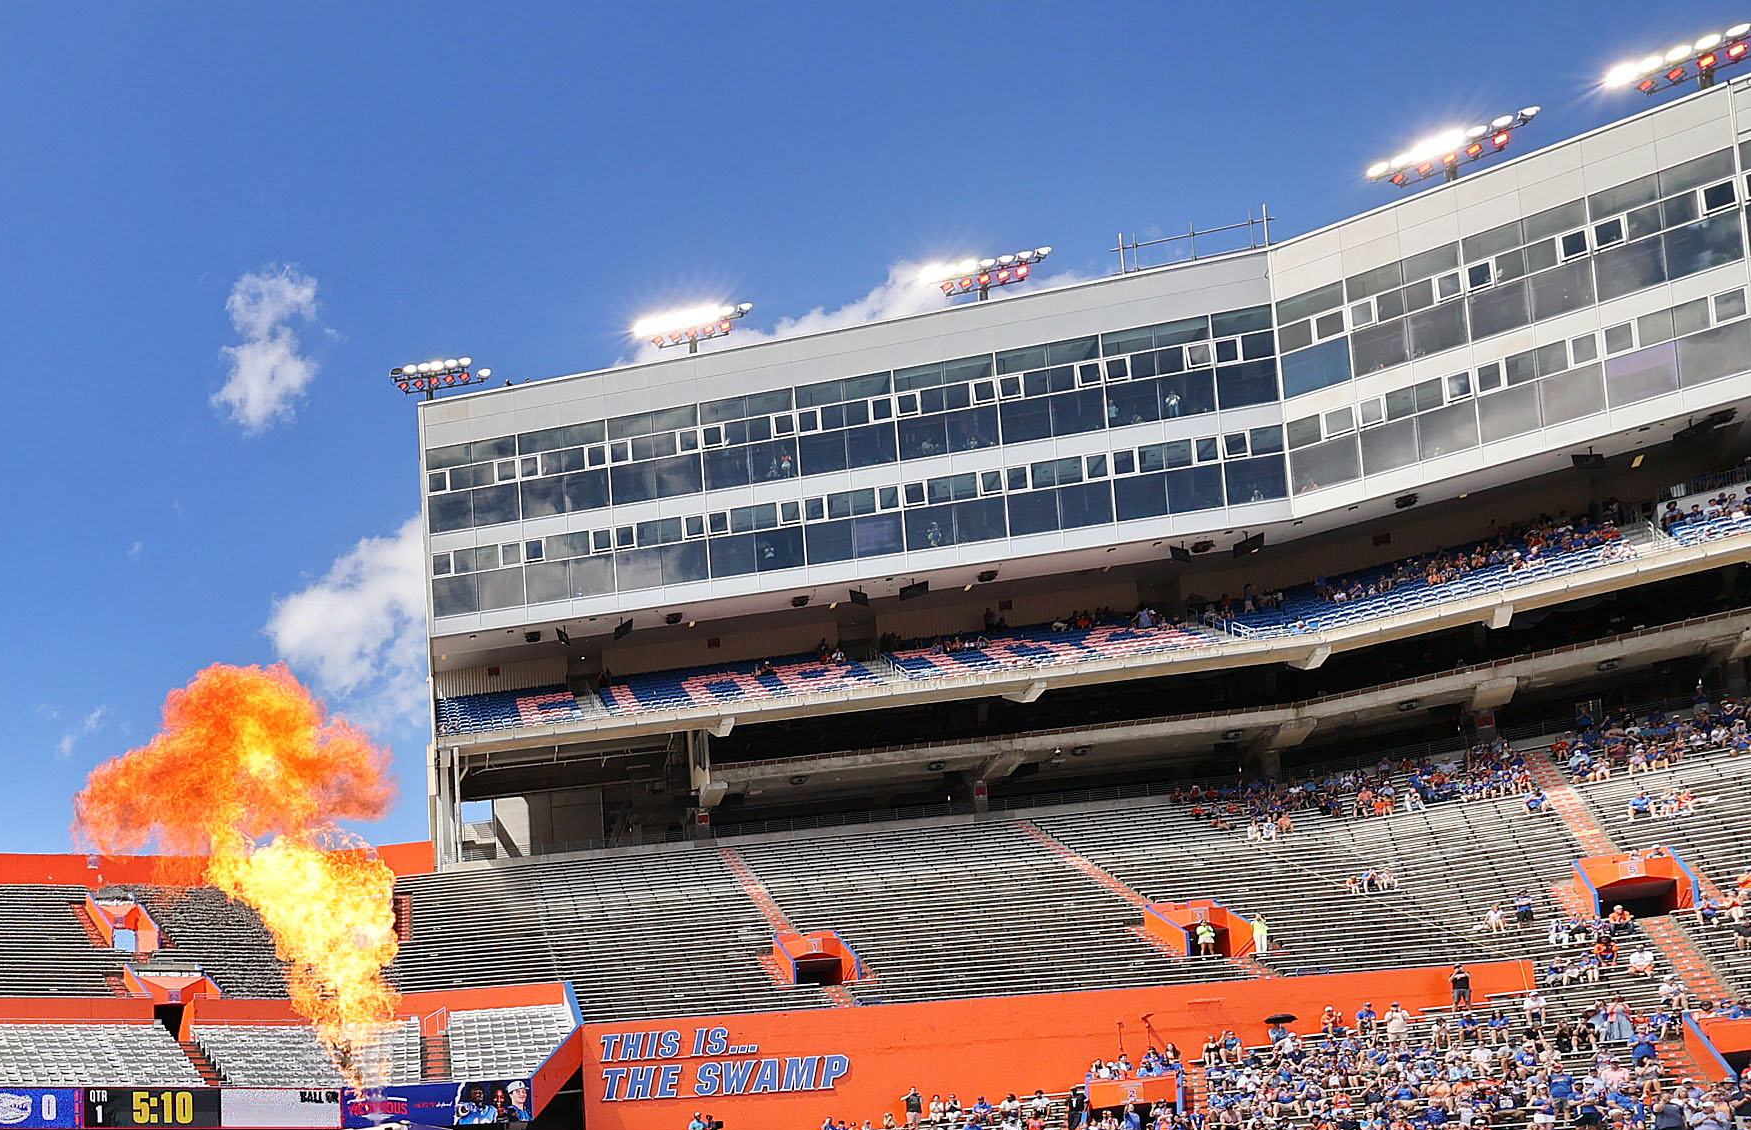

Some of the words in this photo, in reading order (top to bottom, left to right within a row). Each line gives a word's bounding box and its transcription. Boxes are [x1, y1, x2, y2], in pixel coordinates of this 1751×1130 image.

[600, 1030, 681, 1062] THIS
[690, 1027, 758, 1057] IS...
[601, 1064, 682, 1101] THE
[695, 1054, 849, 1096] SWAMP
[41, 1094, 57, 1121] 0
[89, 1090, 108, 1103] QTR
[132, 1091, 193, 1124] 5:10
[95, 1105, 103, 1123] 1
